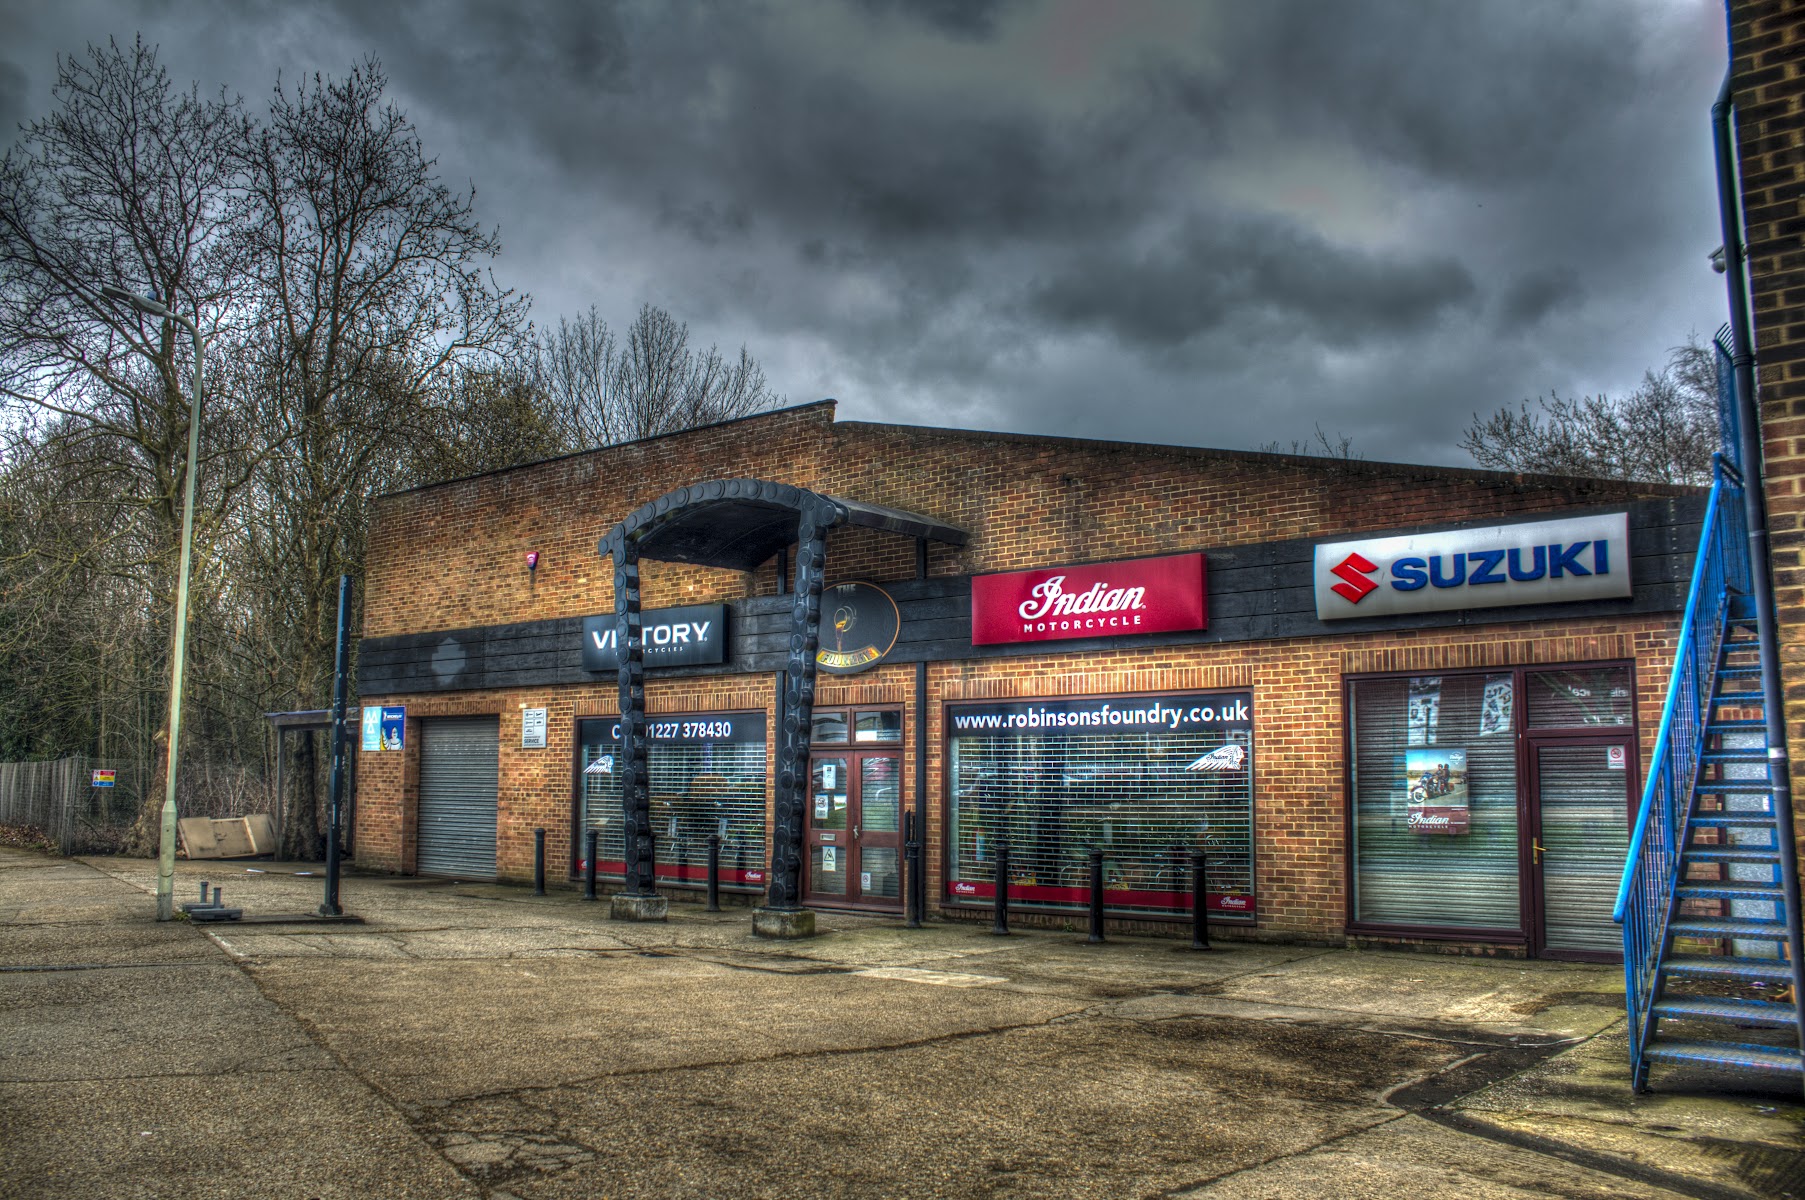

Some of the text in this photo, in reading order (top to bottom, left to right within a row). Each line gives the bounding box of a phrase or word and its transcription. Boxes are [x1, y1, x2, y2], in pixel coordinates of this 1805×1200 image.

[1390, 539, 1610, 592] SUZUKI
[836, 584, 856, 595] THE
[1018, 575, 1146, 620] Indian
[1023, 615, 1141, 633] MOTORCYCLE
[592, 621, 711, 650] VITORY
[954, 700, 1249, 729] www.robinsonsfoundry.co.uk
[682, 721, 732, 738] 378430
[1408, 812, 1450, 825] Indian
[1221, 896, 1246, 905] Indian
